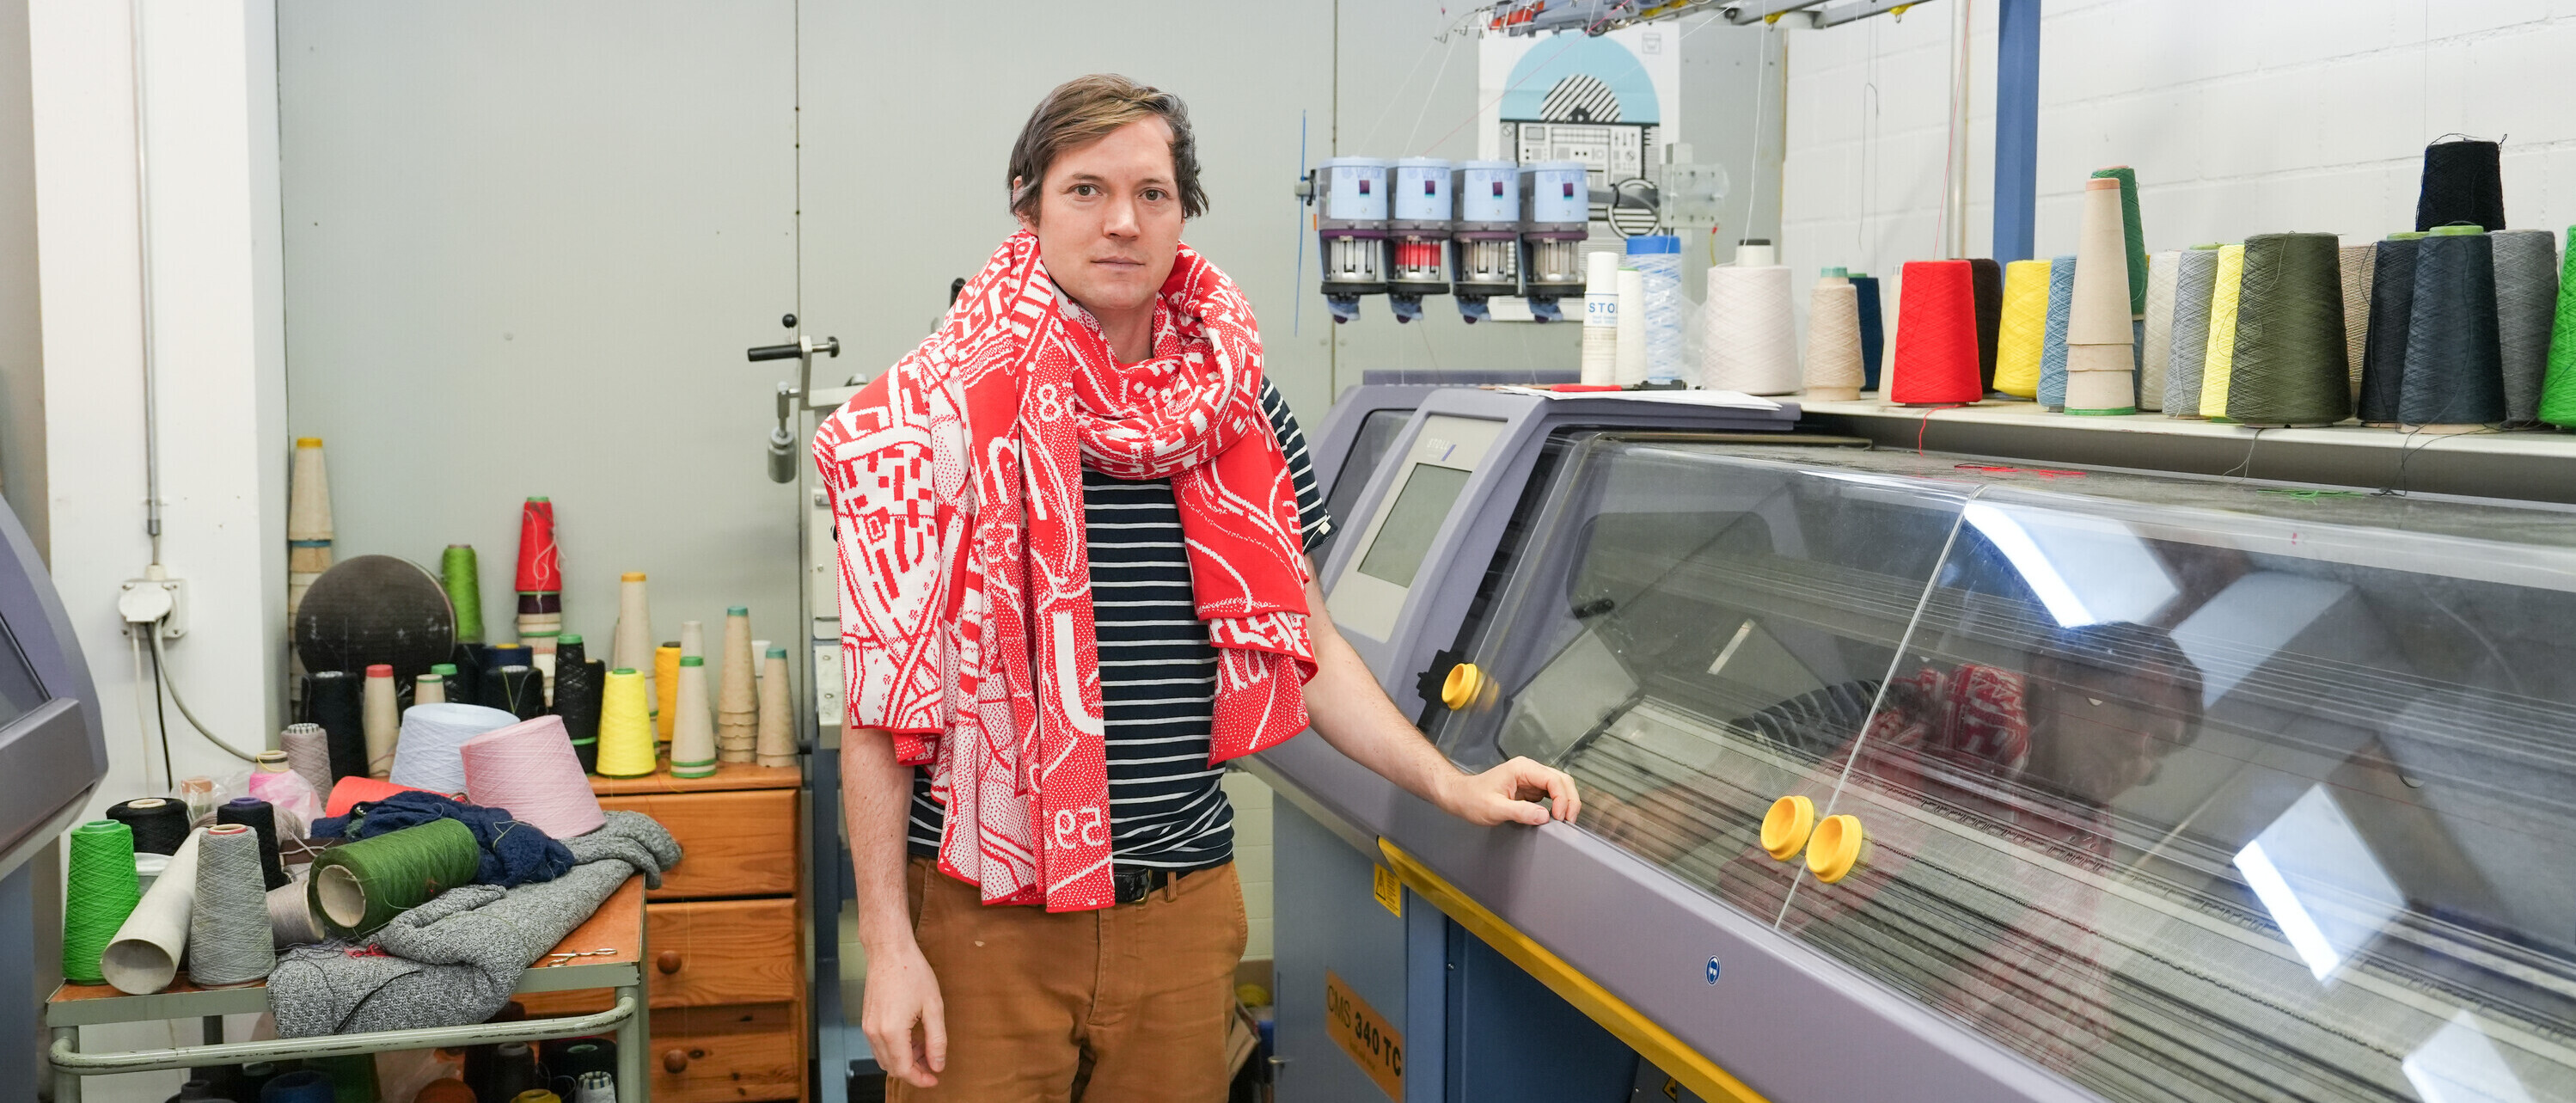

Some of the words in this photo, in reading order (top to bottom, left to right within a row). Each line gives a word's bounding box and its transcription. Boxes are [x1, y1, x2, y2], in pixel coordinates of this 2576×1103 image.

[1327, 985, 1351, 1028] CMS
[1355, 1011, 1380, 1056] 340
[1383, 1036, 1401, 1077] TC
